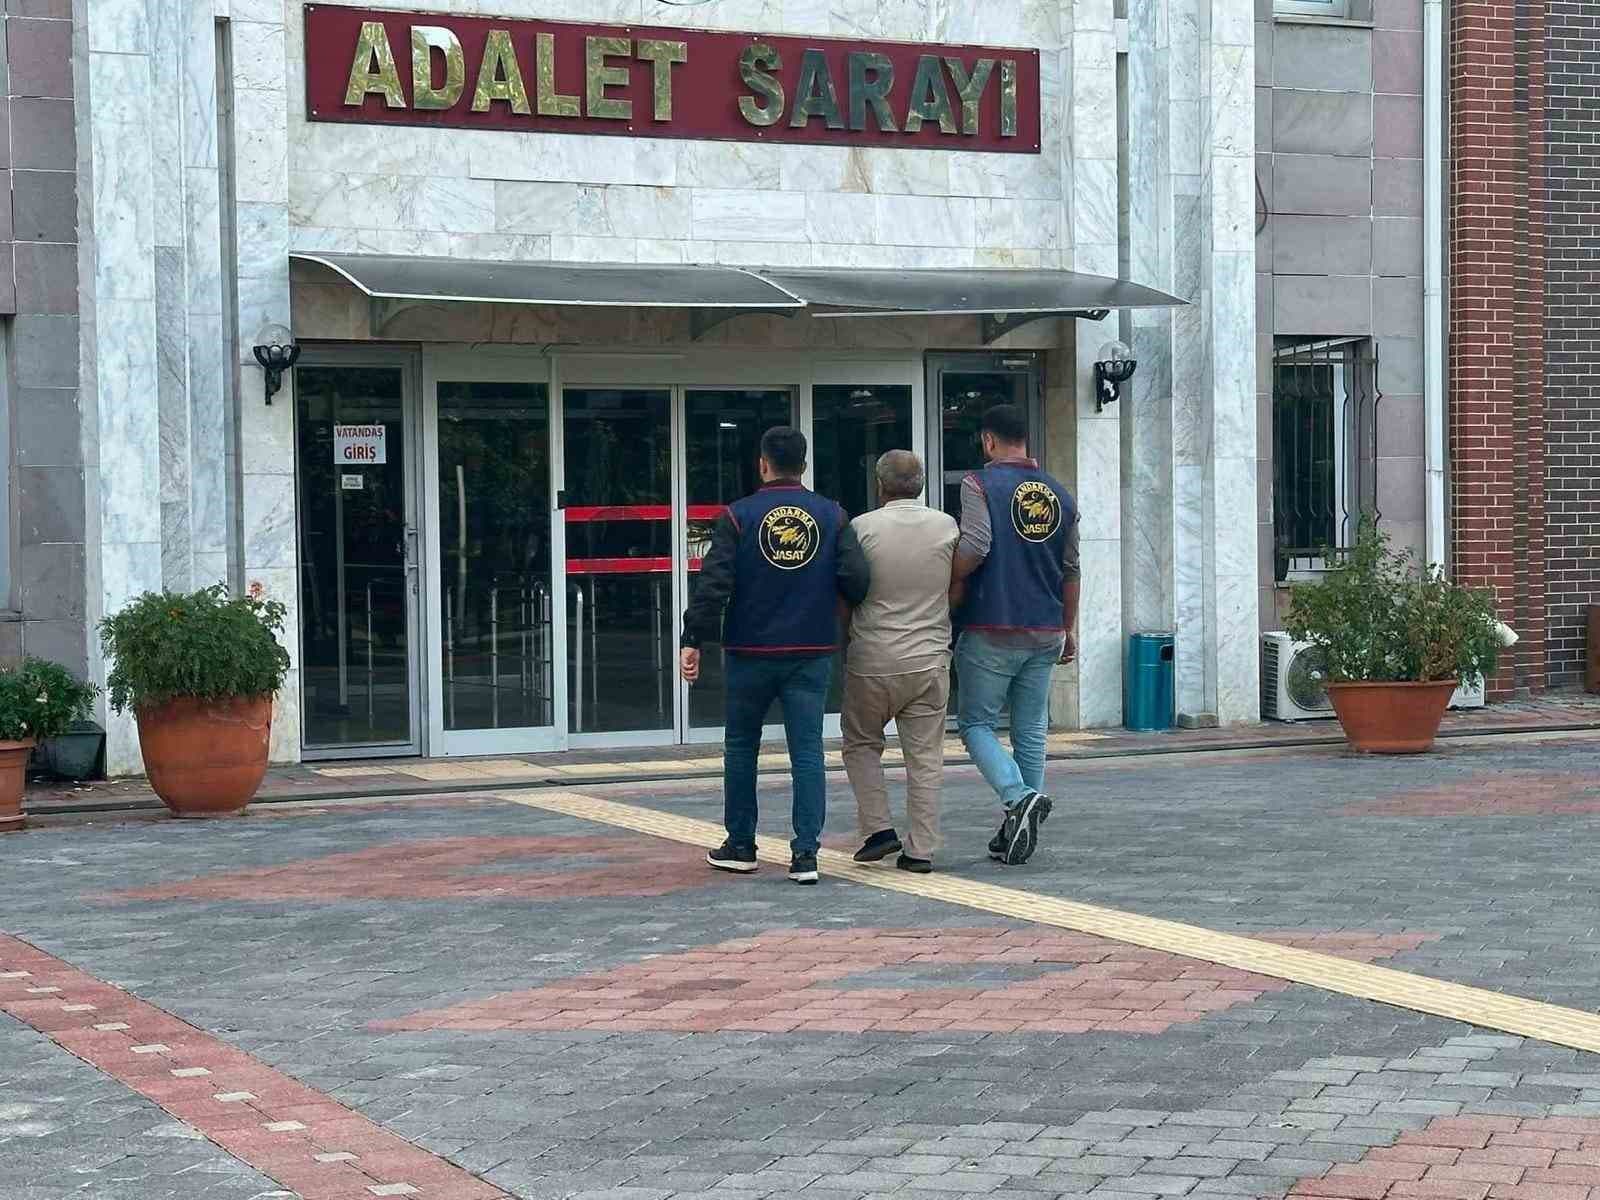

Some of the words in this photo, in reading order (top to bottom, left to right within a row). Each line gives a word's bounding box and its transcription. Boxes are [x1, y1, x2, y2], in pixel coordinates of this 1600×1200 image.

[344, 21, 688, 121] ADALET
[737, 44, 1017, 137] SARAYI
[336, 427, 383, 440] VATANDAŞ
[344, 443, 377, 462] GİRİŞ
[765, 508, 814, 529] JANDARMA
[772, 550, 806, 561] JASAT
